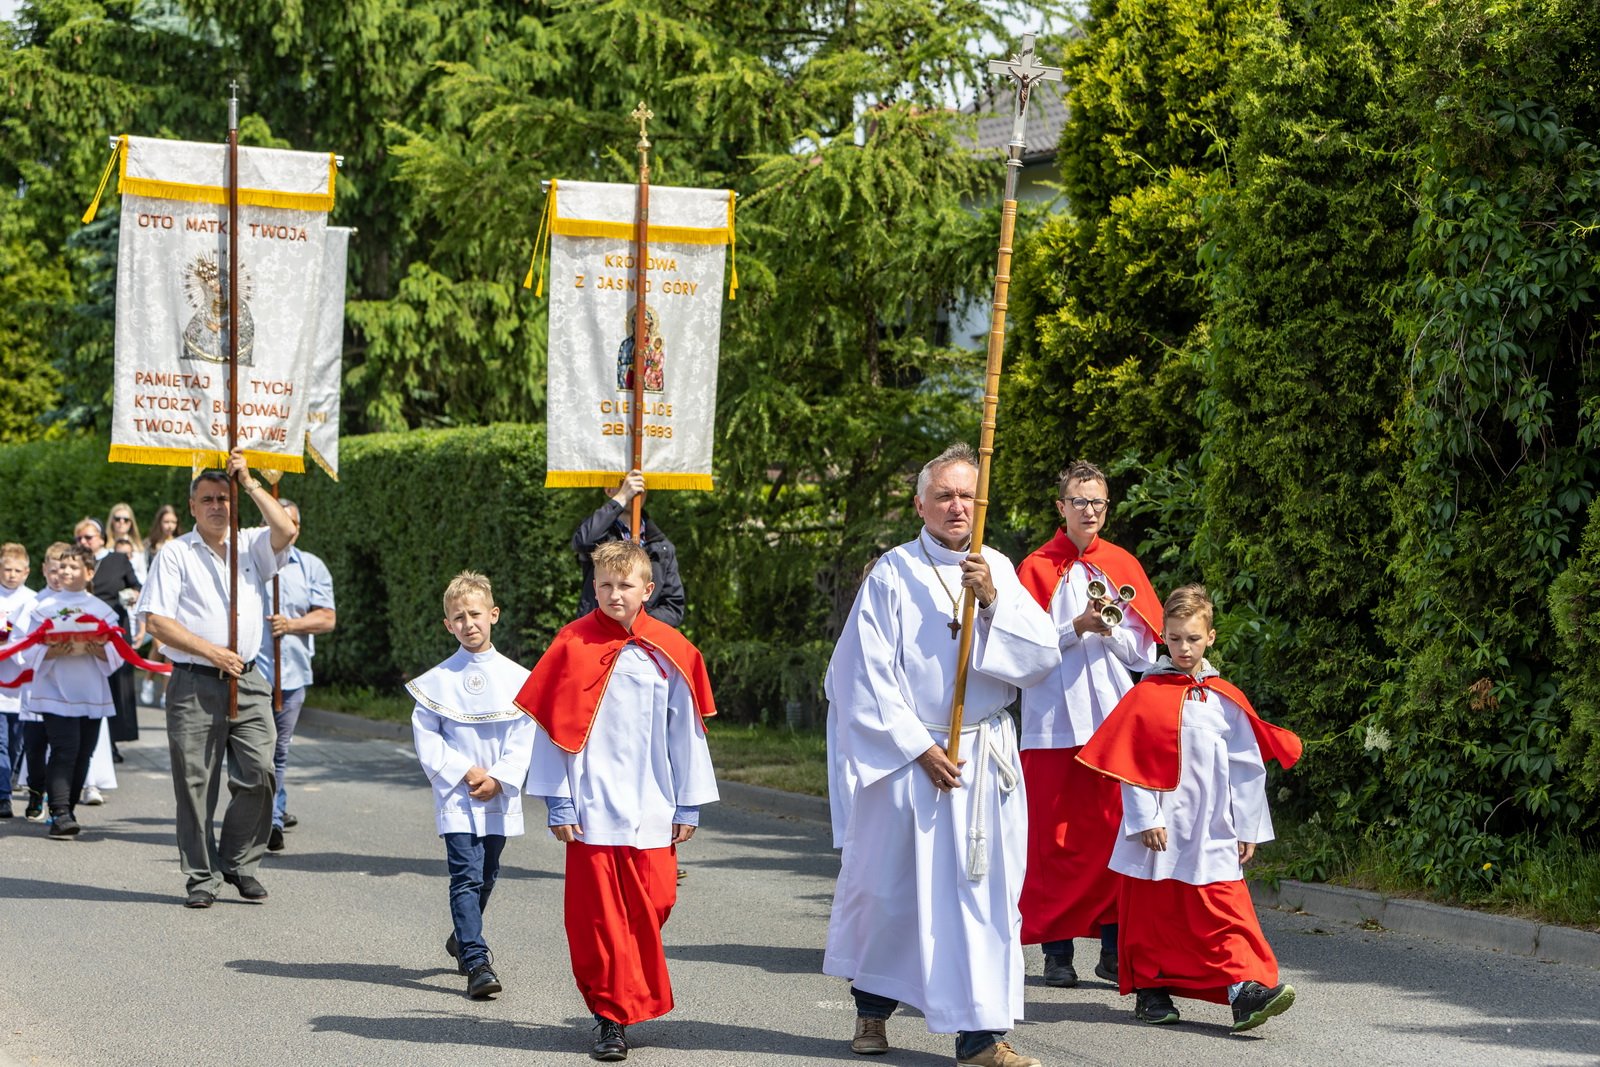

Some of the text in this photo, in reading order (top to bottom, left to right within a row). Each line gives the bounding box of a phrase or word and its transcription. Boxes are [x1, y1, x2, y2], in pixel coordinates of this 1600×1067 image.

[138, 213, 307, 242] OTO MATK TWOJA
[604, 253, 677, 271] KRÓOWA
[575, 275, 585, 288] Z
[662, 279, 698, 296] GÓRY
[135, 371, 211, 391] PAMIĘTAJ
[250, 380, 293, 396] TYCH
[134, 391, 201, 412] KTÓRZY
[600, 399, 673, 416] CIELICE
